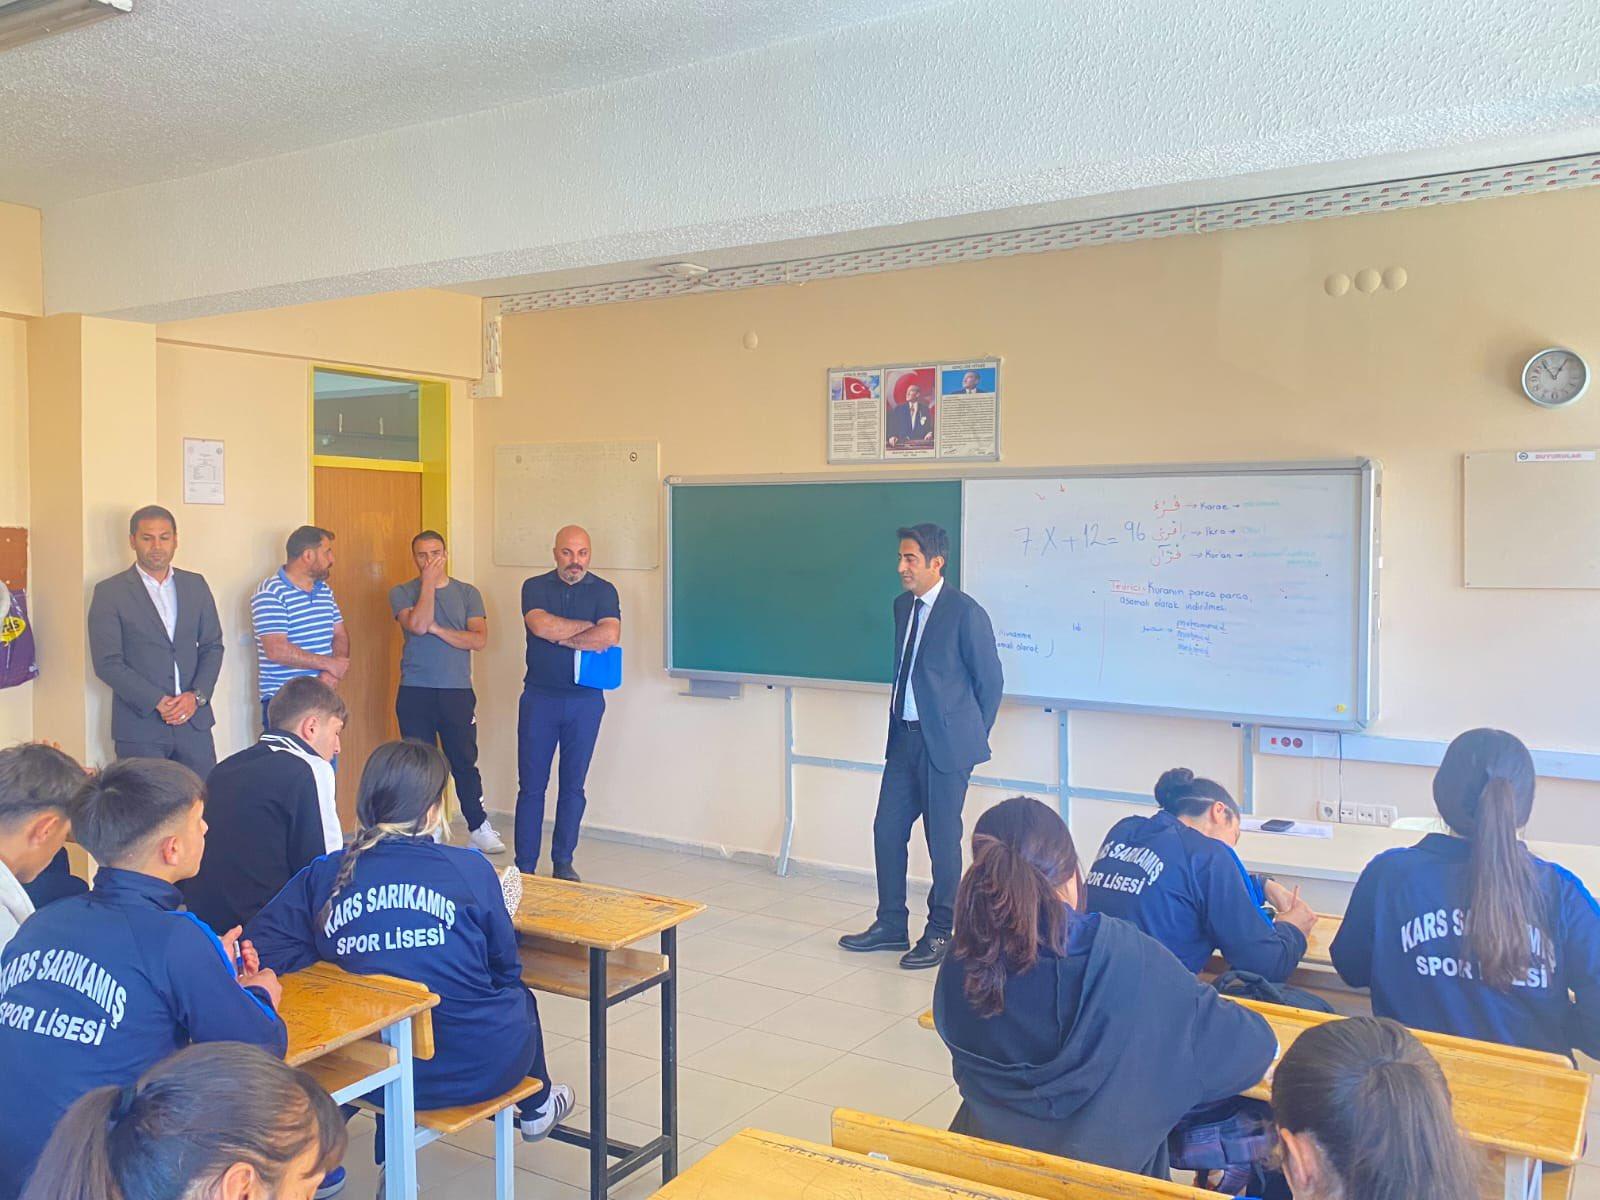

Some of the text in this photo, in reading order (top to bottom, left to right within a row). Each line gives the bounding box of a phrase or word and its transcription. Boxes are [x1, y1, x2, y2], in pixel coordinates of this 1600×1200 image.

[1103, 872, 1146, 895] LİSESİ
[323, 883, 456, 938] KARS SARIKAMIŞ
[1401, 909, 1448, 952] KARS
[336, 923, 446, 955] SPOR LİSESİ
[0, 949, 127, 1029] KARS SARIKAMIŞ
[34, 1007, 107, 1046] LİSESİ
